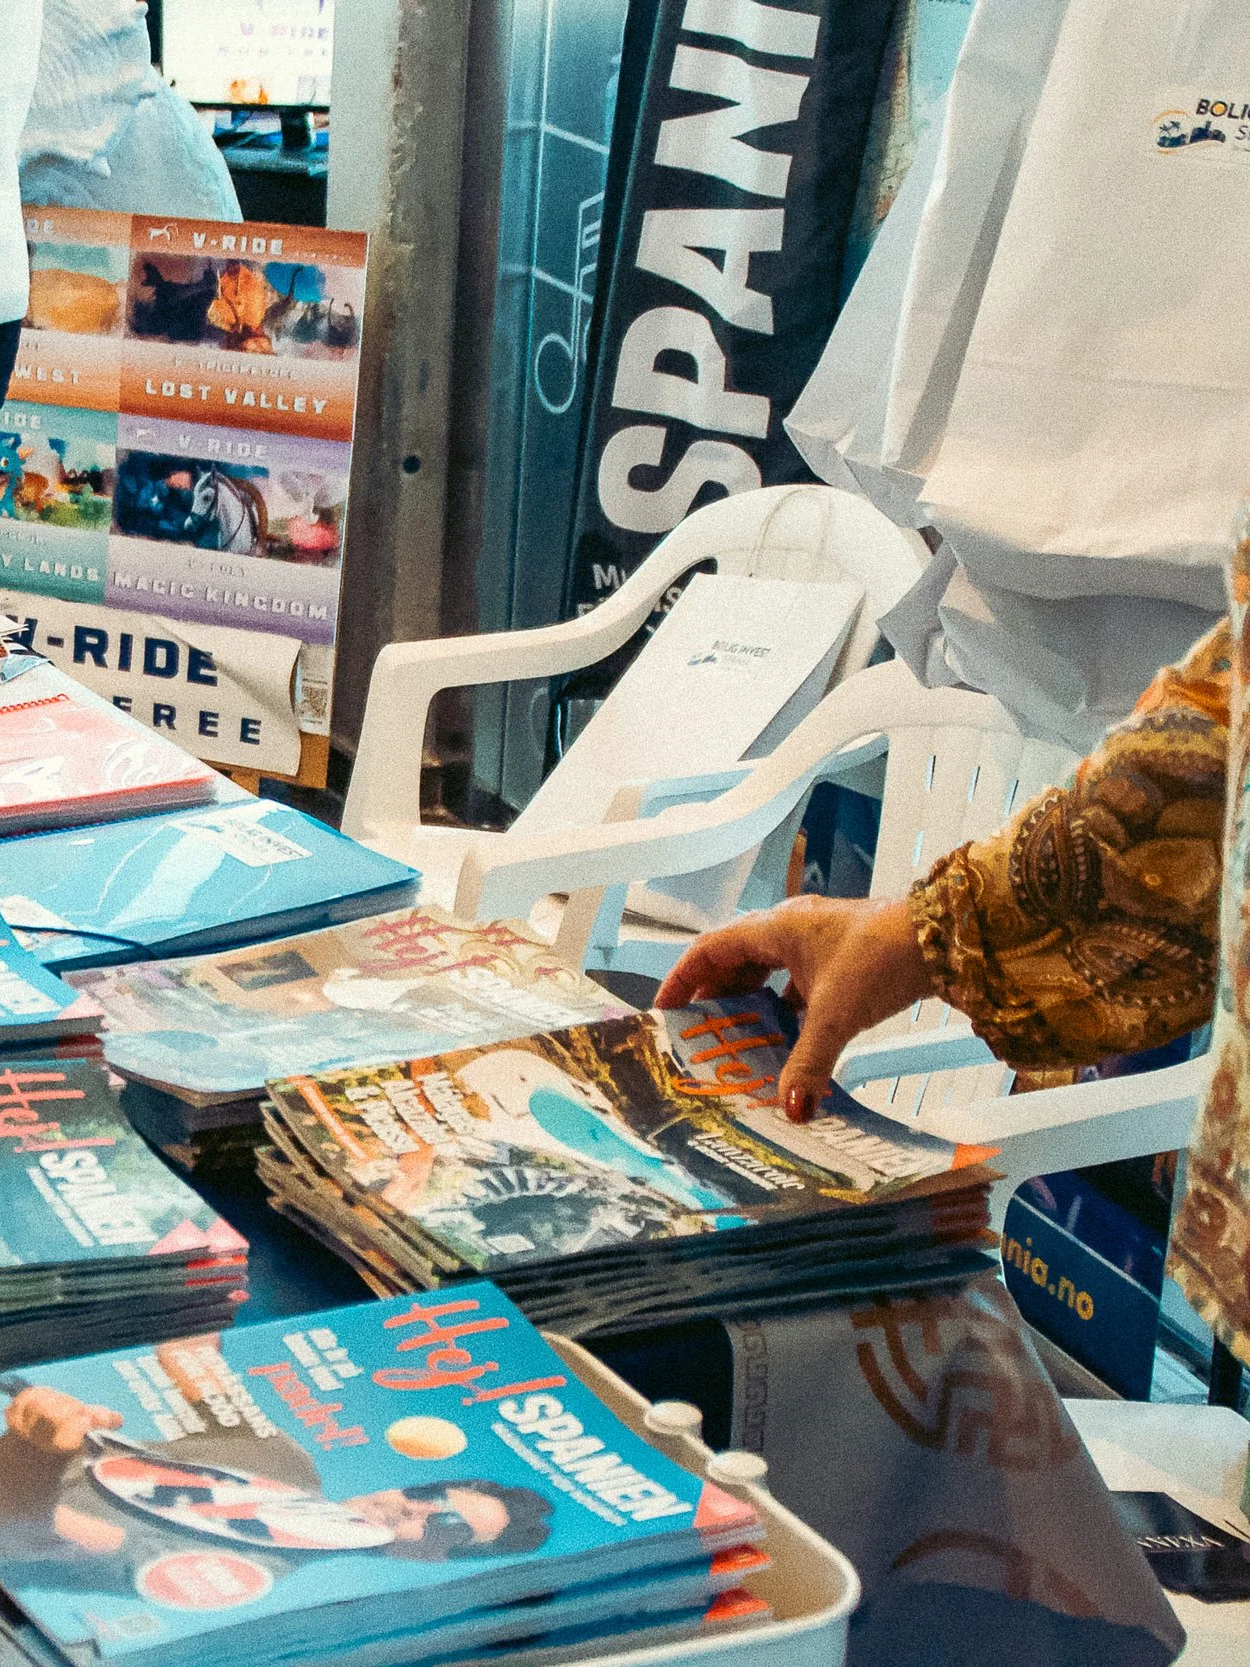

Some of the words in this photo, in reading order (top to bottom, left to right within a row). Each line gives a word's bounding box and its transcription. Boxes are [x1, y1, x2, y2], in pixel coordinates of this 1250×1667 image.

[192, 231, 283, 256] V-RIDE
[145, 378, 212, 401] LOST
[225, 387, 328, 415] VALLEY
[112, 569, 194, 600] MAGIC
[205, 583, 328, 622] KINGDOM
[372, 1299, 567, 1406] Hej!
[498, 1393, 693, 1523] SPANIEN
